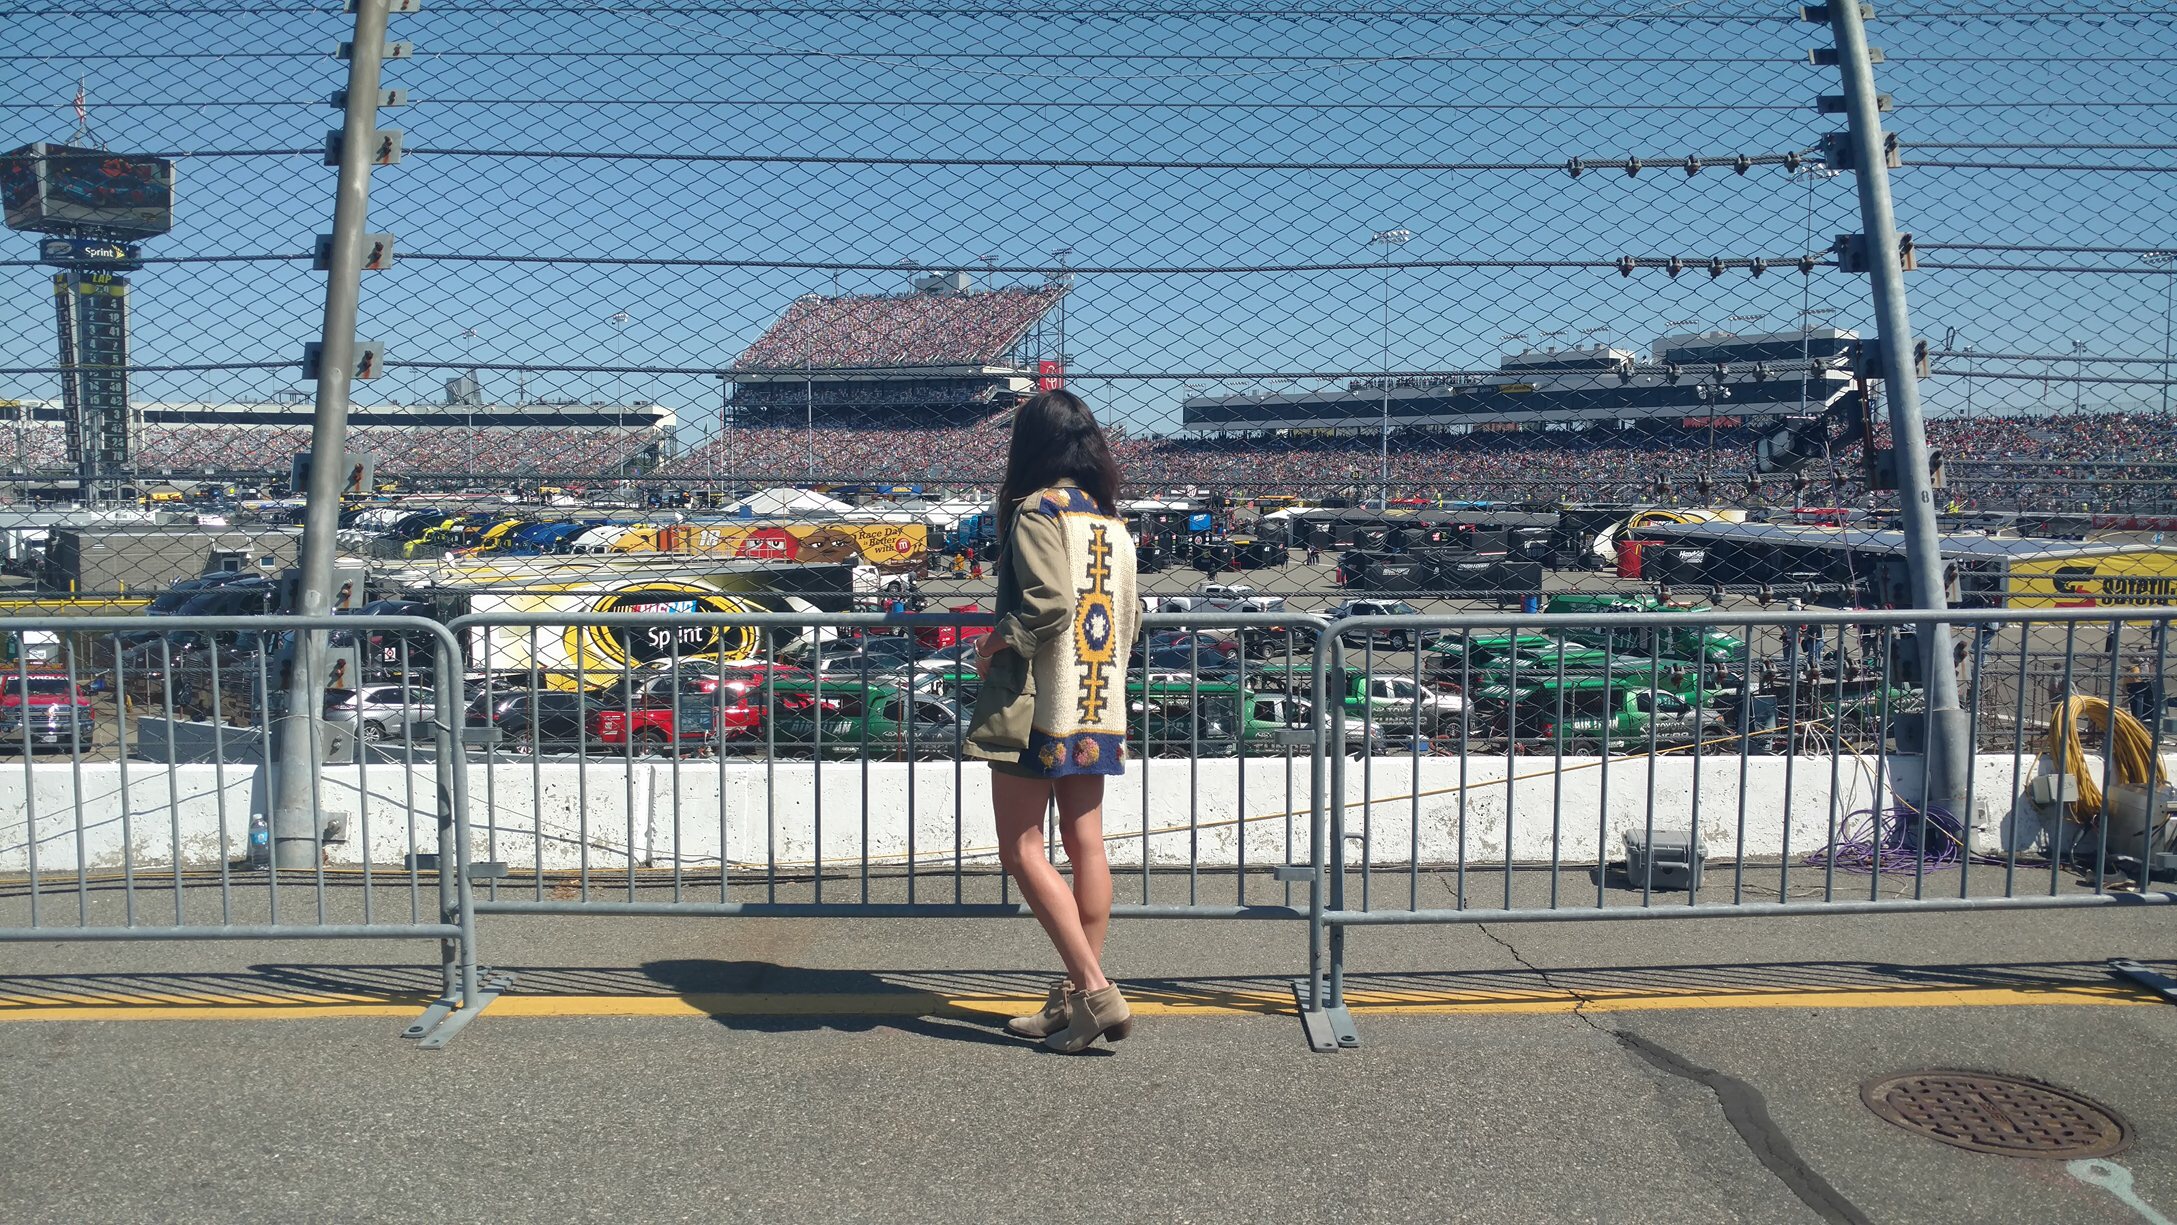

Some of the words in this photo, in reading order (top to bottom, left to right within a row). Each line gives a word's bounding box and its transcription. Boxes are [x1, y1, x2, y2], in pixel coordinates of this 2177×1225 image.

[85, 247, 113, 257] Sprint
[92, 274, 112, 283] LAP
[1922, 490, 1930, 504] 8
[859, 531, 882, 540] Race
[884, 528, 902, 537] Day
[648, 626, 702, 652] Spint
